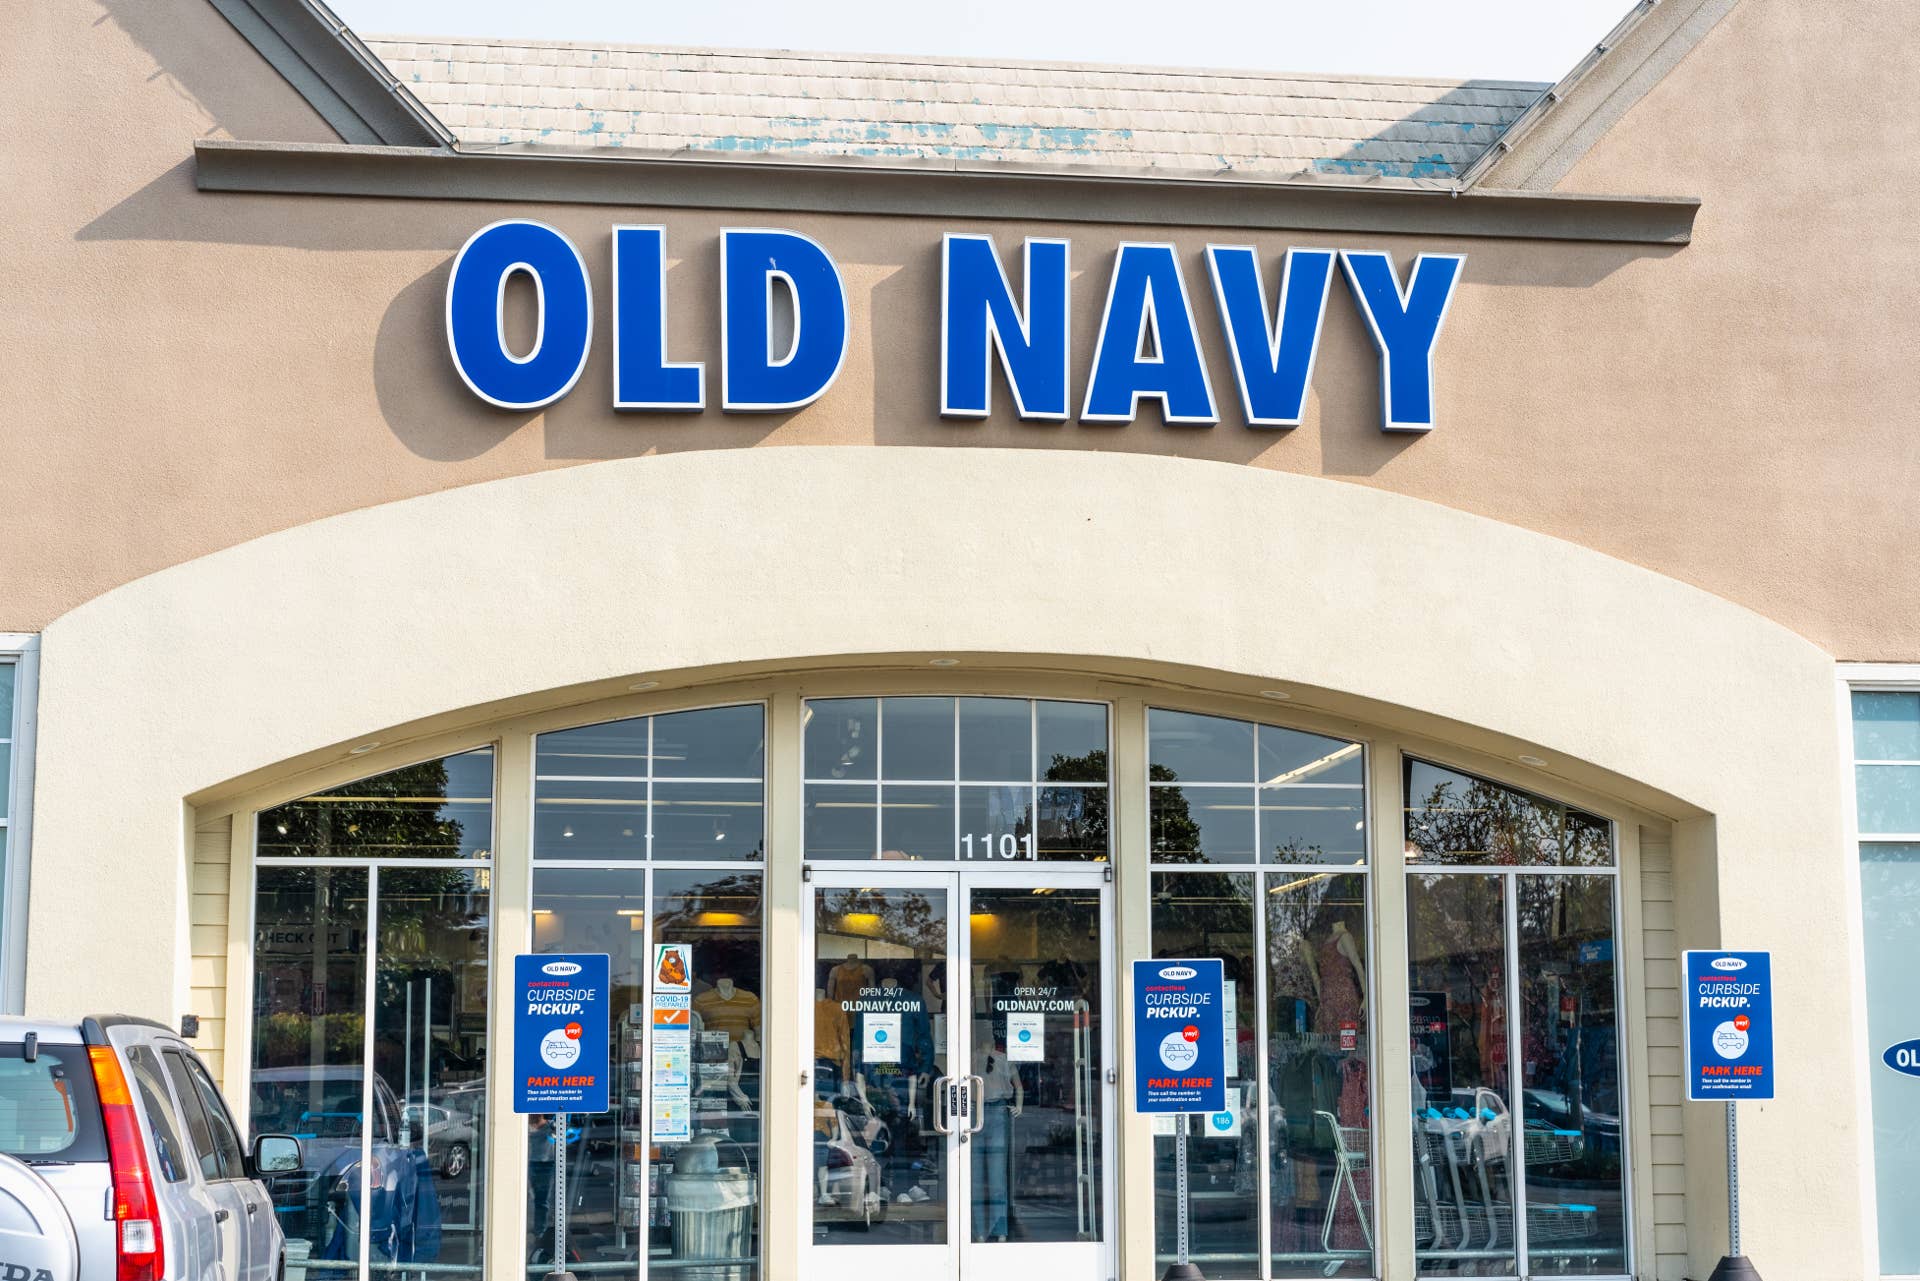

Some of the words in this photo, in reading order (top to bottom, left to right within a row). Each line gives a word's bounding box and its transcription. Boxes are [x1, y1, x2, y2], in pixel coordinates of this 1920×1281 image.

[446, 218, 850, 412] OLD
[939, 231, 1468, 433] NAVY
[961, 833, 1032, 859] 1101
[527, 988, 596, 1002] CURBSIDE
[859, 987, 881, 997] OPEN
[883, 987, 904, 998] 24/7
[1014, 987, 1036, 996] OPEN
[1038, 987, 1057, 998] 24/7
[1698, 983, 1761, 995] CURBSIDE
[655, 995, 689, 1003] COVID-19
[1145, 992, 1212, 1005] CURBSIDE
[1699, 996, 1751, 1008] PICKUP.
[527, 1002, 584, 1015] PICKUP.
[841, 1000, 921, 1012] OLDNAVY.COM
[996, 1000, 1074, 1012] OLDNAVY.COM
[1146, 1006, 1201, 1019] PICKUP.
[567, 1027, 580, 1035] yay!
[1702, 1066, 1731, 1076] PARK
[1733, 1066, 1763, 1076] HERE
[527, 1076, 559, 1086] PARK
[562, 1075, 595, 1086] HERE
[1148, 1078, 1179, 1088] PARK
[1181, 1077, 1213, 1088] HERE
